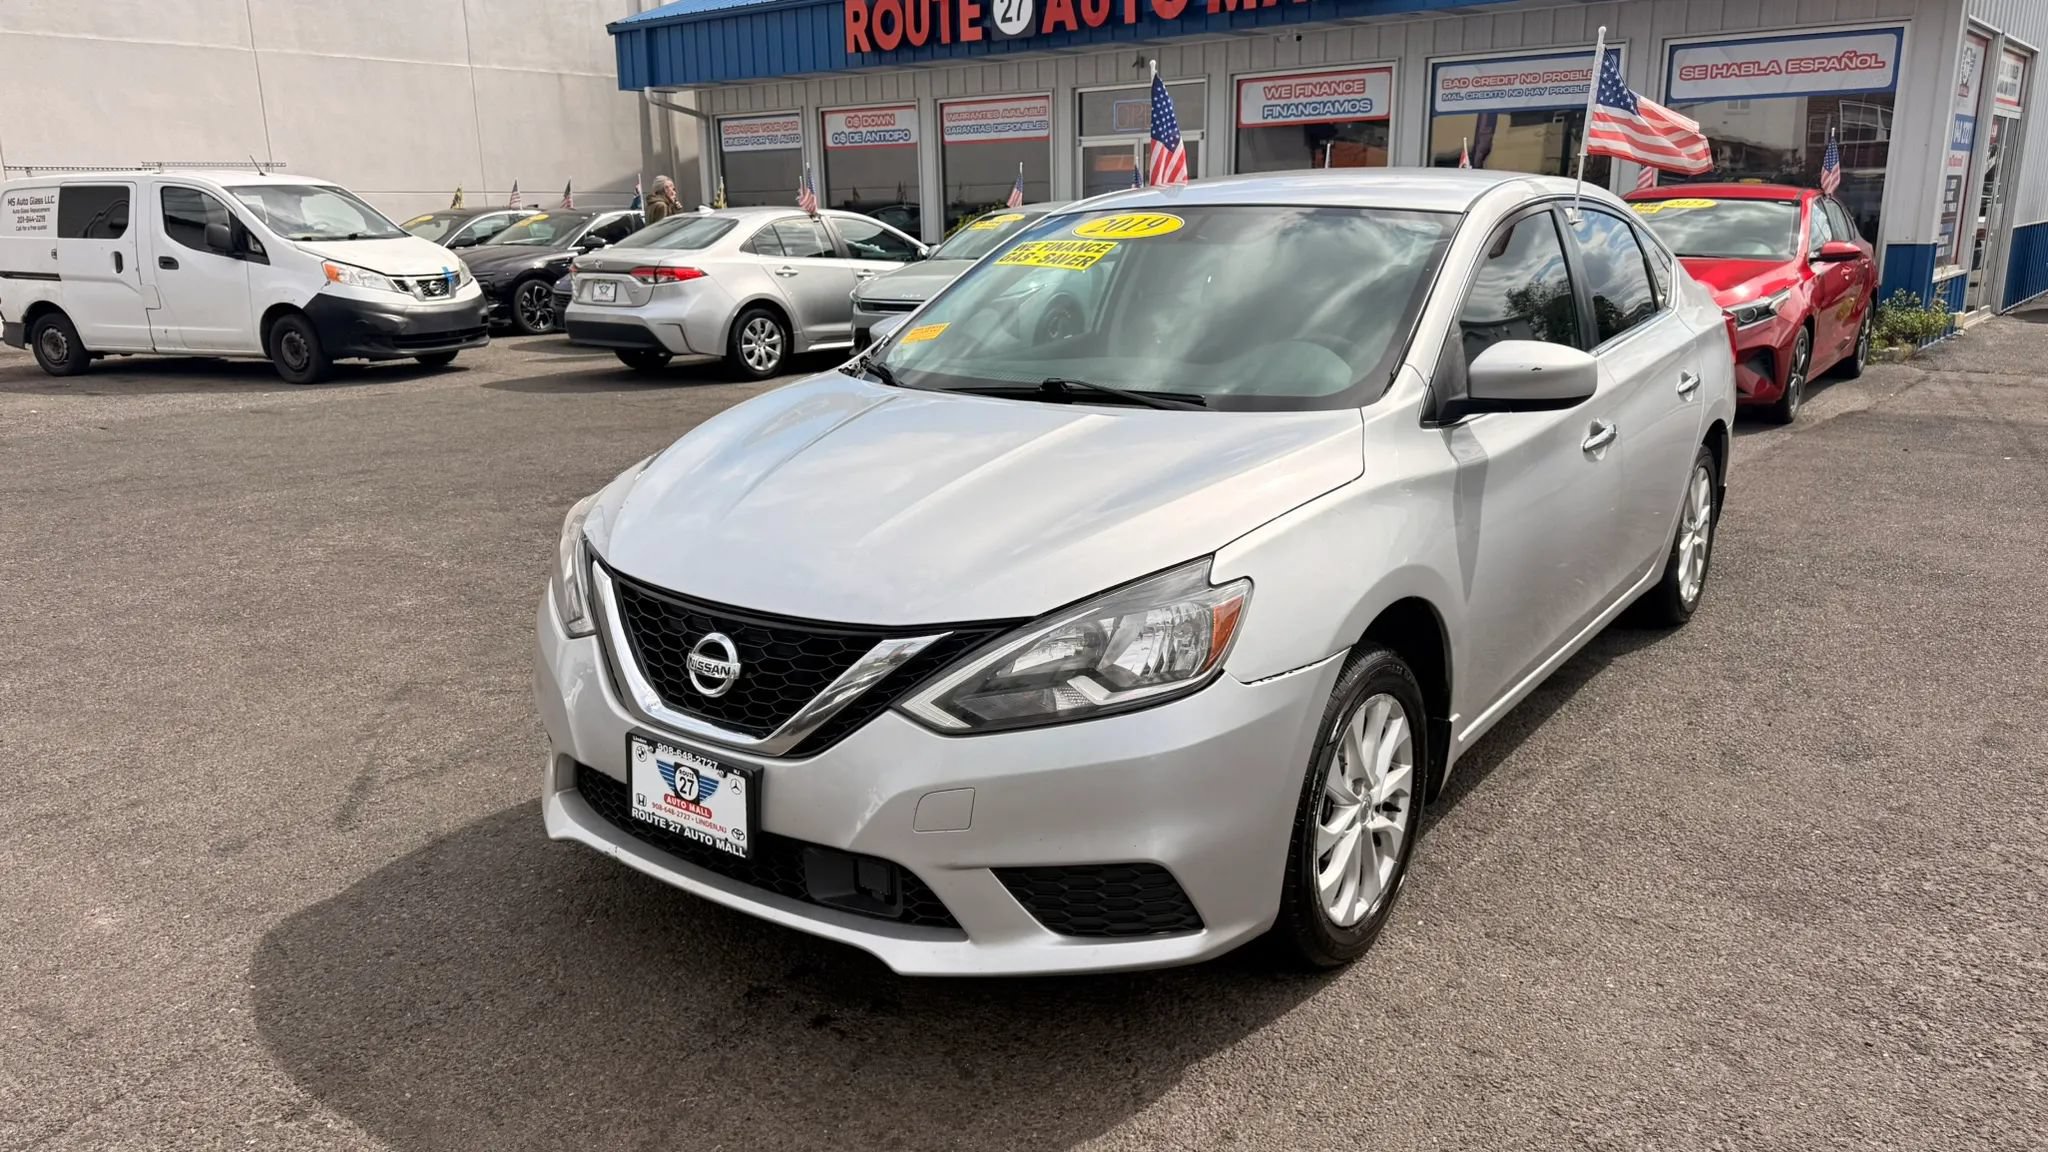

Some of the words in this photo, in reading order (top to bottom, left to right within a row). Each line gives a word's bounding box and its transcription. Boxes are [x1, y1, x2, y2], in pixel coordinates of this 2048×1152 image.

[845, 0, 983, 53] ROUTE
[1000, 0, 1024, 23] 27
[1680, 65, 1706, 80] SE
[1710, 60, 1780, 79] HABLA
[1785, 50, 1886, 74] ESPAÑOL
[1442, 78, 1468, 89] BAD
[1471, 74, 1518, 88] CREDIT
[1520, 73, 1540, 84] NO
[1543, 69, 1593, 83] PROBLE
[1263, 84, 1292, 100] WE
[1294, 78, 1366, 98] FINANCE
[1441, 92, 1464, 102] MAL
[1464, 90, 1506, 100] CREDITO
[1507, 88, 1524, 98] NO
[1525, 86, 1547, 97] HAY
[946, 110, 1000, 122] WARRANTIES
[1001, 106, 1047, 119] AVAILABLE
[1262, 98, 1372, 120] FINANCIAMOS
[862, 113, 896, 127] DOWN
[944, 124, 993, 136] GARANTIAS
[993, 120, 1048, 133] DISPONIBLES
[750, 135, 766, 145] POR
[767, 135, 779, 144] TU
[780, 133, 800, 144] AUTO
[848, 131, 863, 144] DE
[864, 128, 911, 143] ANTICIPO
[17, 197, 28, 206] Auto
[45, 195, 55, 204] LLC
[1087, 217, 1169, 234] 2019
[1016, 243, 1037, 252] WE
[1041, 241, 1113, 254] FINANCE
[688, 657, 731, 676] NISSAN
[679, 769, 695, 779] ROUTE
[679, 776, 695, 796] 27
[666, 796, 687, 809] AUTO
[689, 803, 710, 817] MALL
[632, 808, 666, 828] ROUTE
[668, 821, 682, 833] 27
[684, 828, 713, 845] AUTO
[716, 838, 746, 858] MALL
